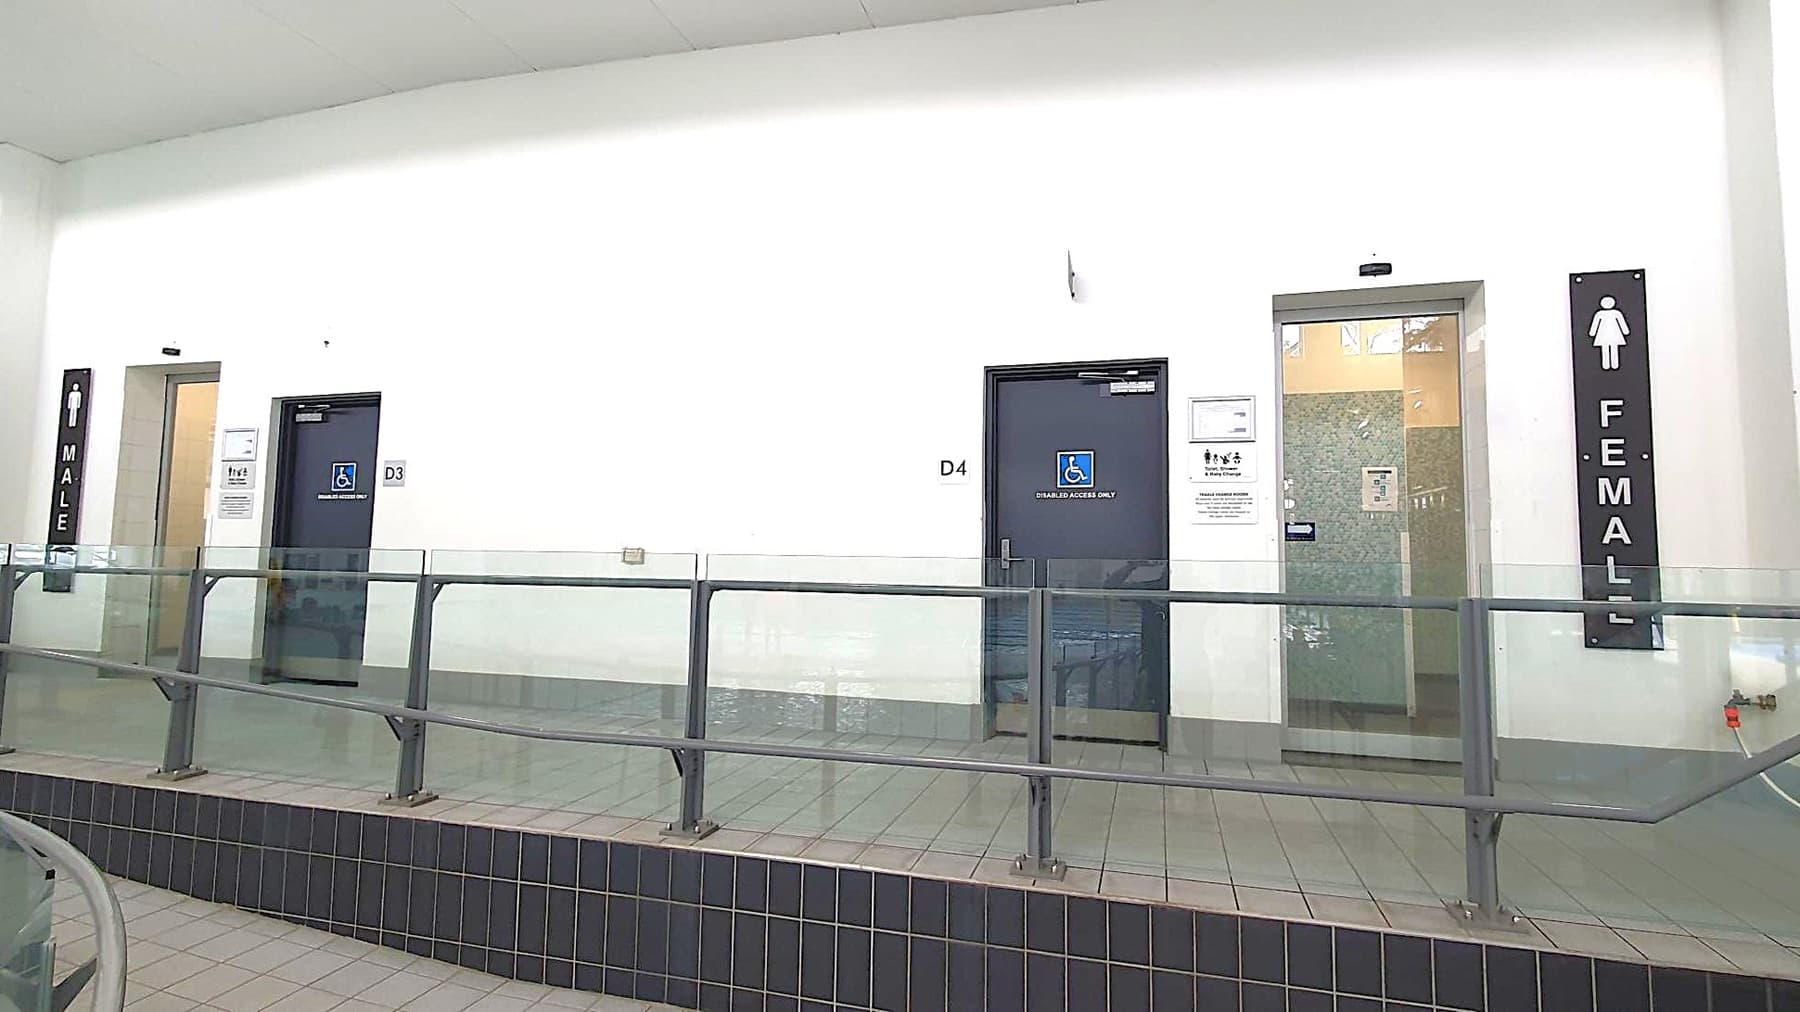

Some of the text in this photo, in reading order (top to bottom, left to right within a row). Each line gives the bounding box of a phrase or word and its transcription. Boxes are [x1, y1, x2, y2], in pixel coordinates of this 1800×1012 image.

[57, 444, 76, 531] MALE
[385, 466, 404, 481] D3
[940, 459, 968, 477] D4
[1598, 399, 1634, 624] FEMALE
